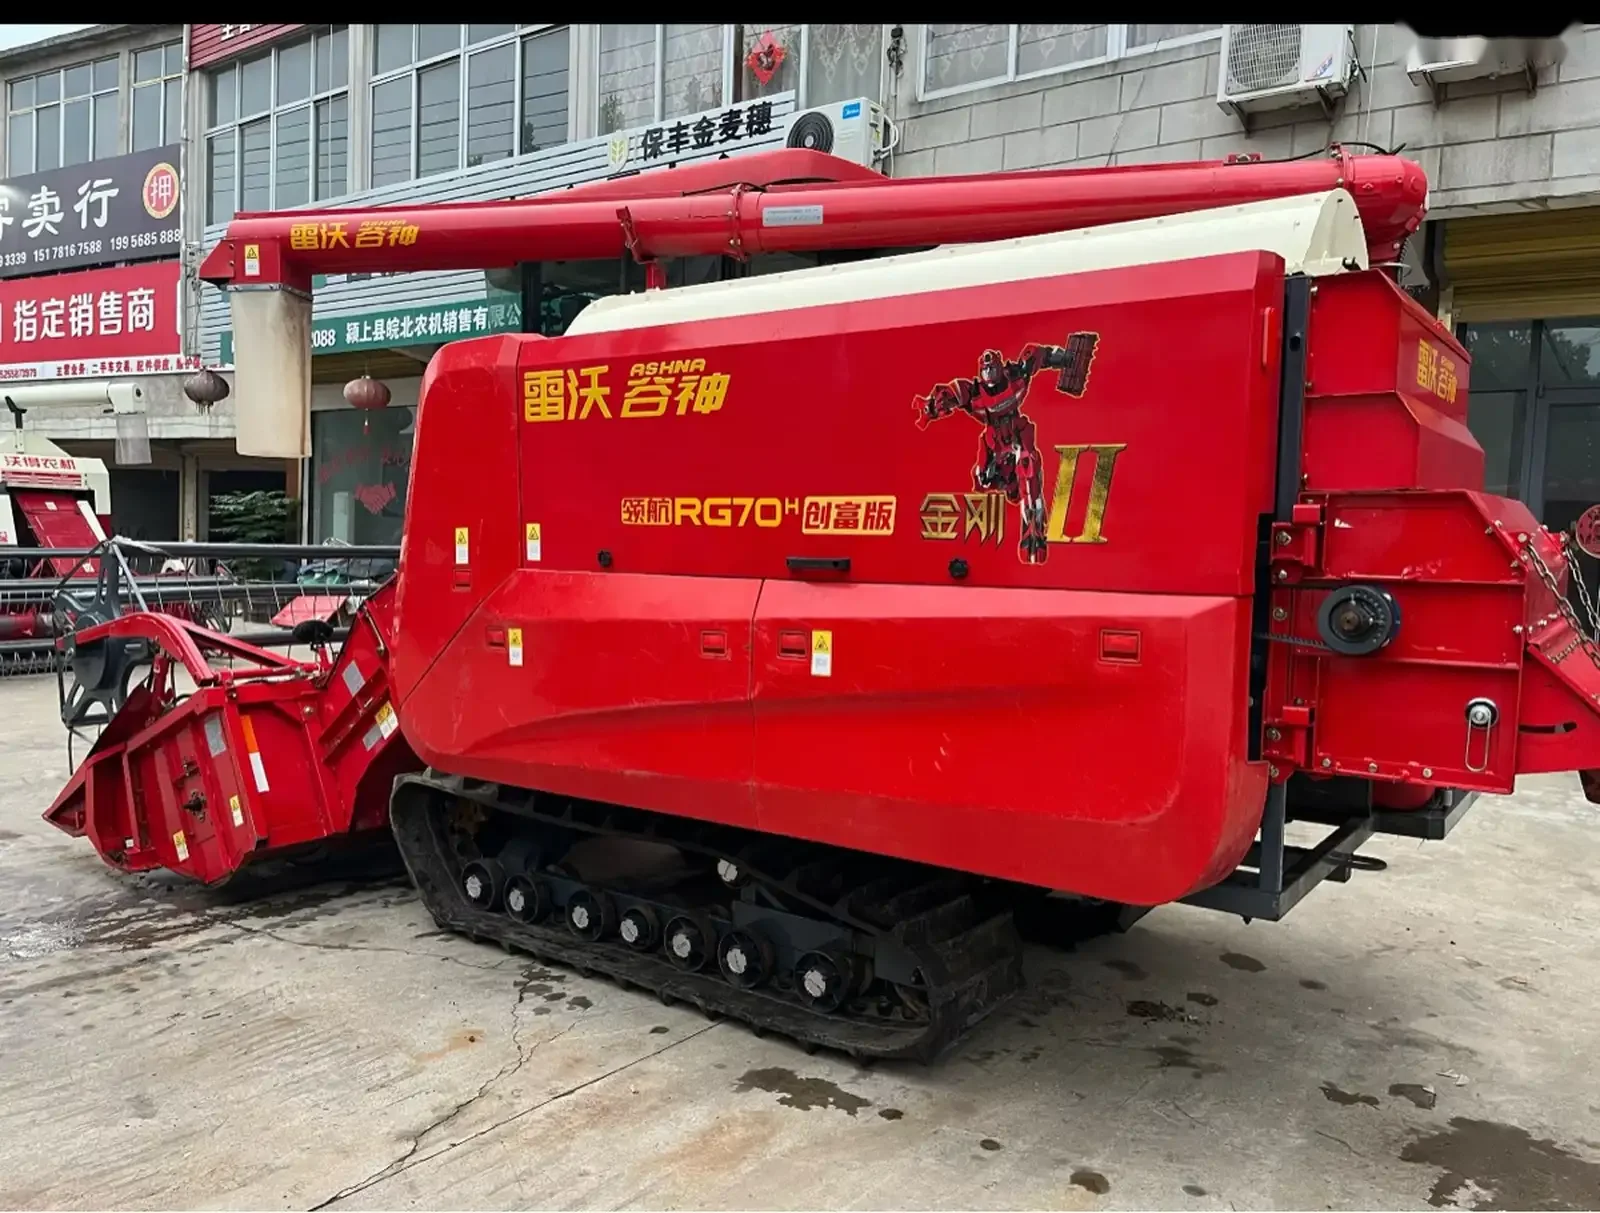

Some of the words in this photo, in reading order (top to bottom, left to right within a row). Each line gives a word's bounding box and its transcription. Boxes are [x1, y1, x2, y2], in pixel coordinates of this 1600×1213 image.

[641, 101, 774, 161] 保丰金麦穗
[150, 174, 173, 208] 押
[290, 222, 350, 250] 雷沃
[355, 225, 420, 249] 谷神
[13, 287, 155, 343] 指定销售商
[311, 328, 337, 348] 088
[630, 358, 706, 377] ASHNA
[1417, 338, 1438, 395] 雷沃
[524, 365, 612, 423] 雷沃
[620, 372, 731, 419] 谷神
[621, 497, 673, 525] 领航
[803, 498, 895, 533] 创富版
[920, 493, 1007, 546] 金刚
